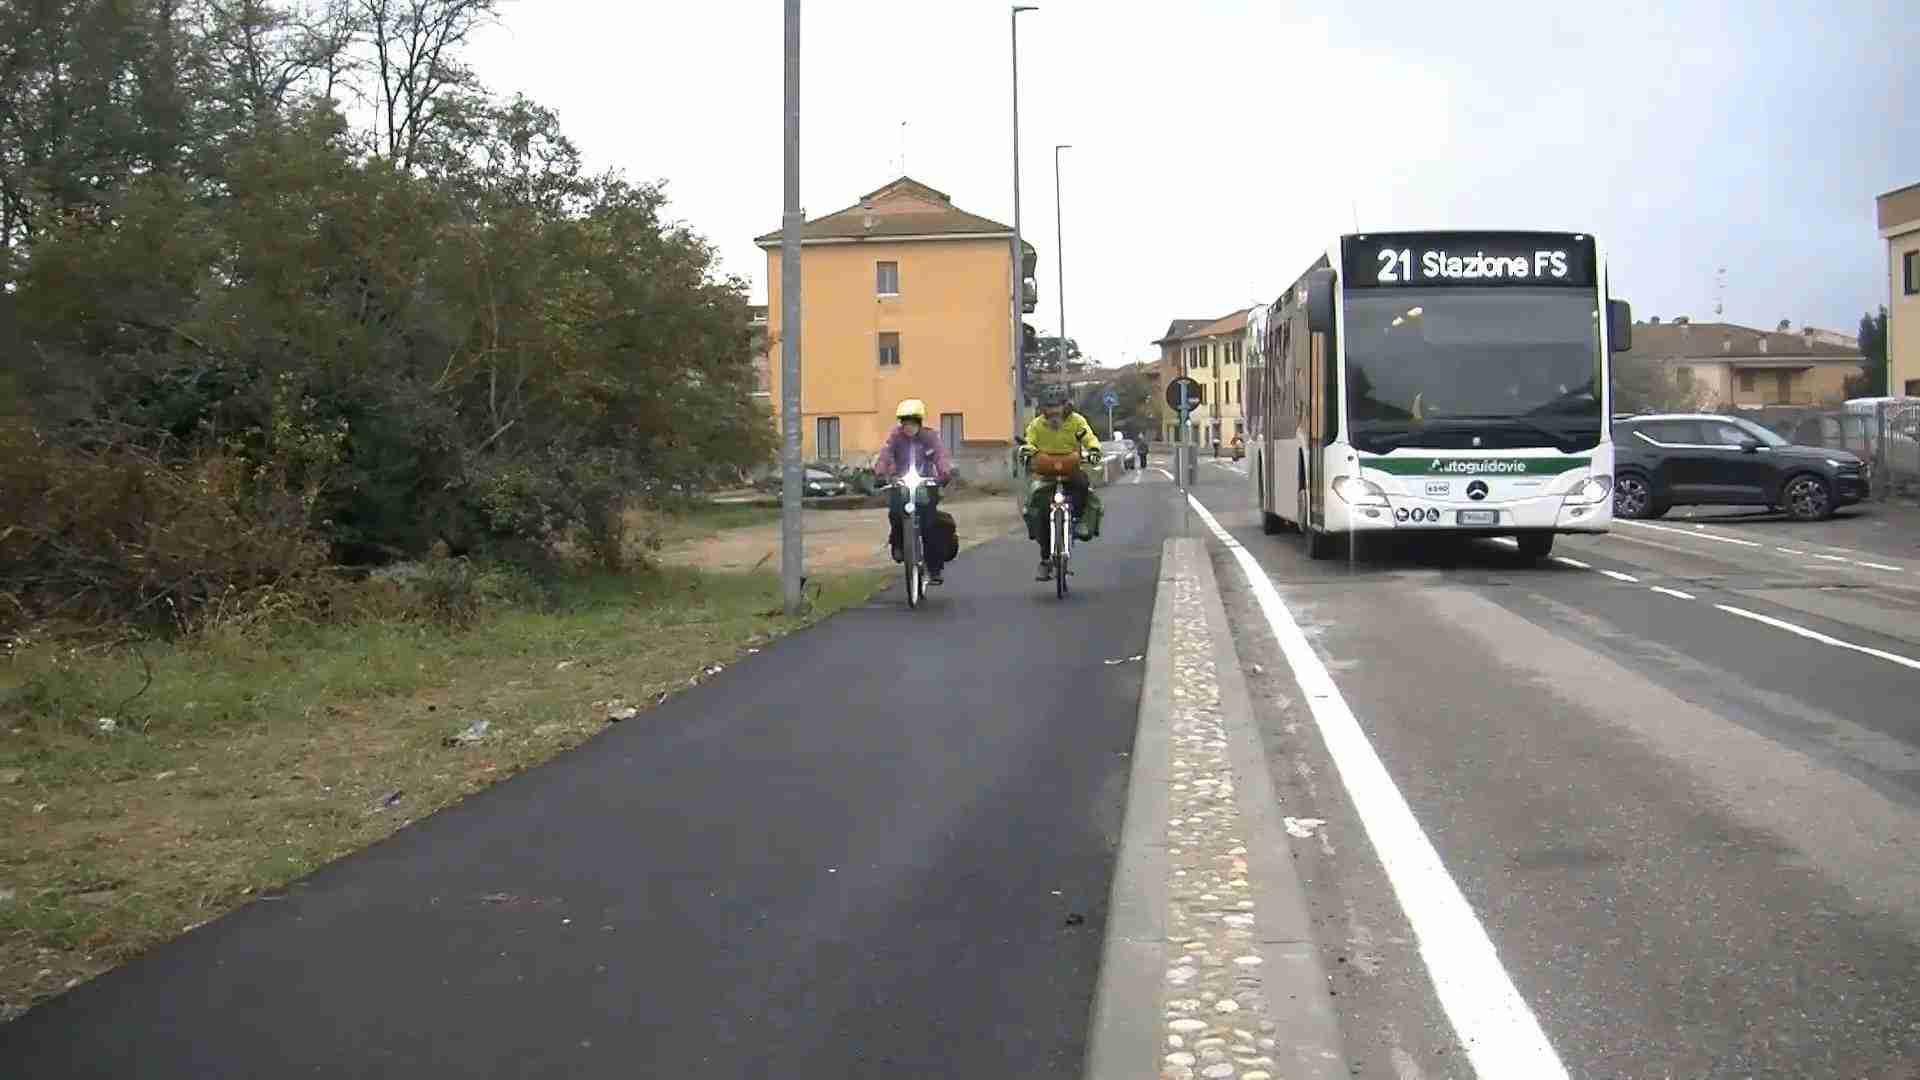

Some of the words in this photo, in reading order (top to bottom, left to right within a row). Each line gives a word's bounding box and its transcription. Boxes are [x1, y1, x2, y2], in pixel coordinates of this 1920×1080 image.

[1377, 248, 1412, 281] 21
[1423, 250, 1528, 277] Stazione
[1534, 251, 1568, 277] FS
[1429, 460, 1526, 474] Autoguidovie
